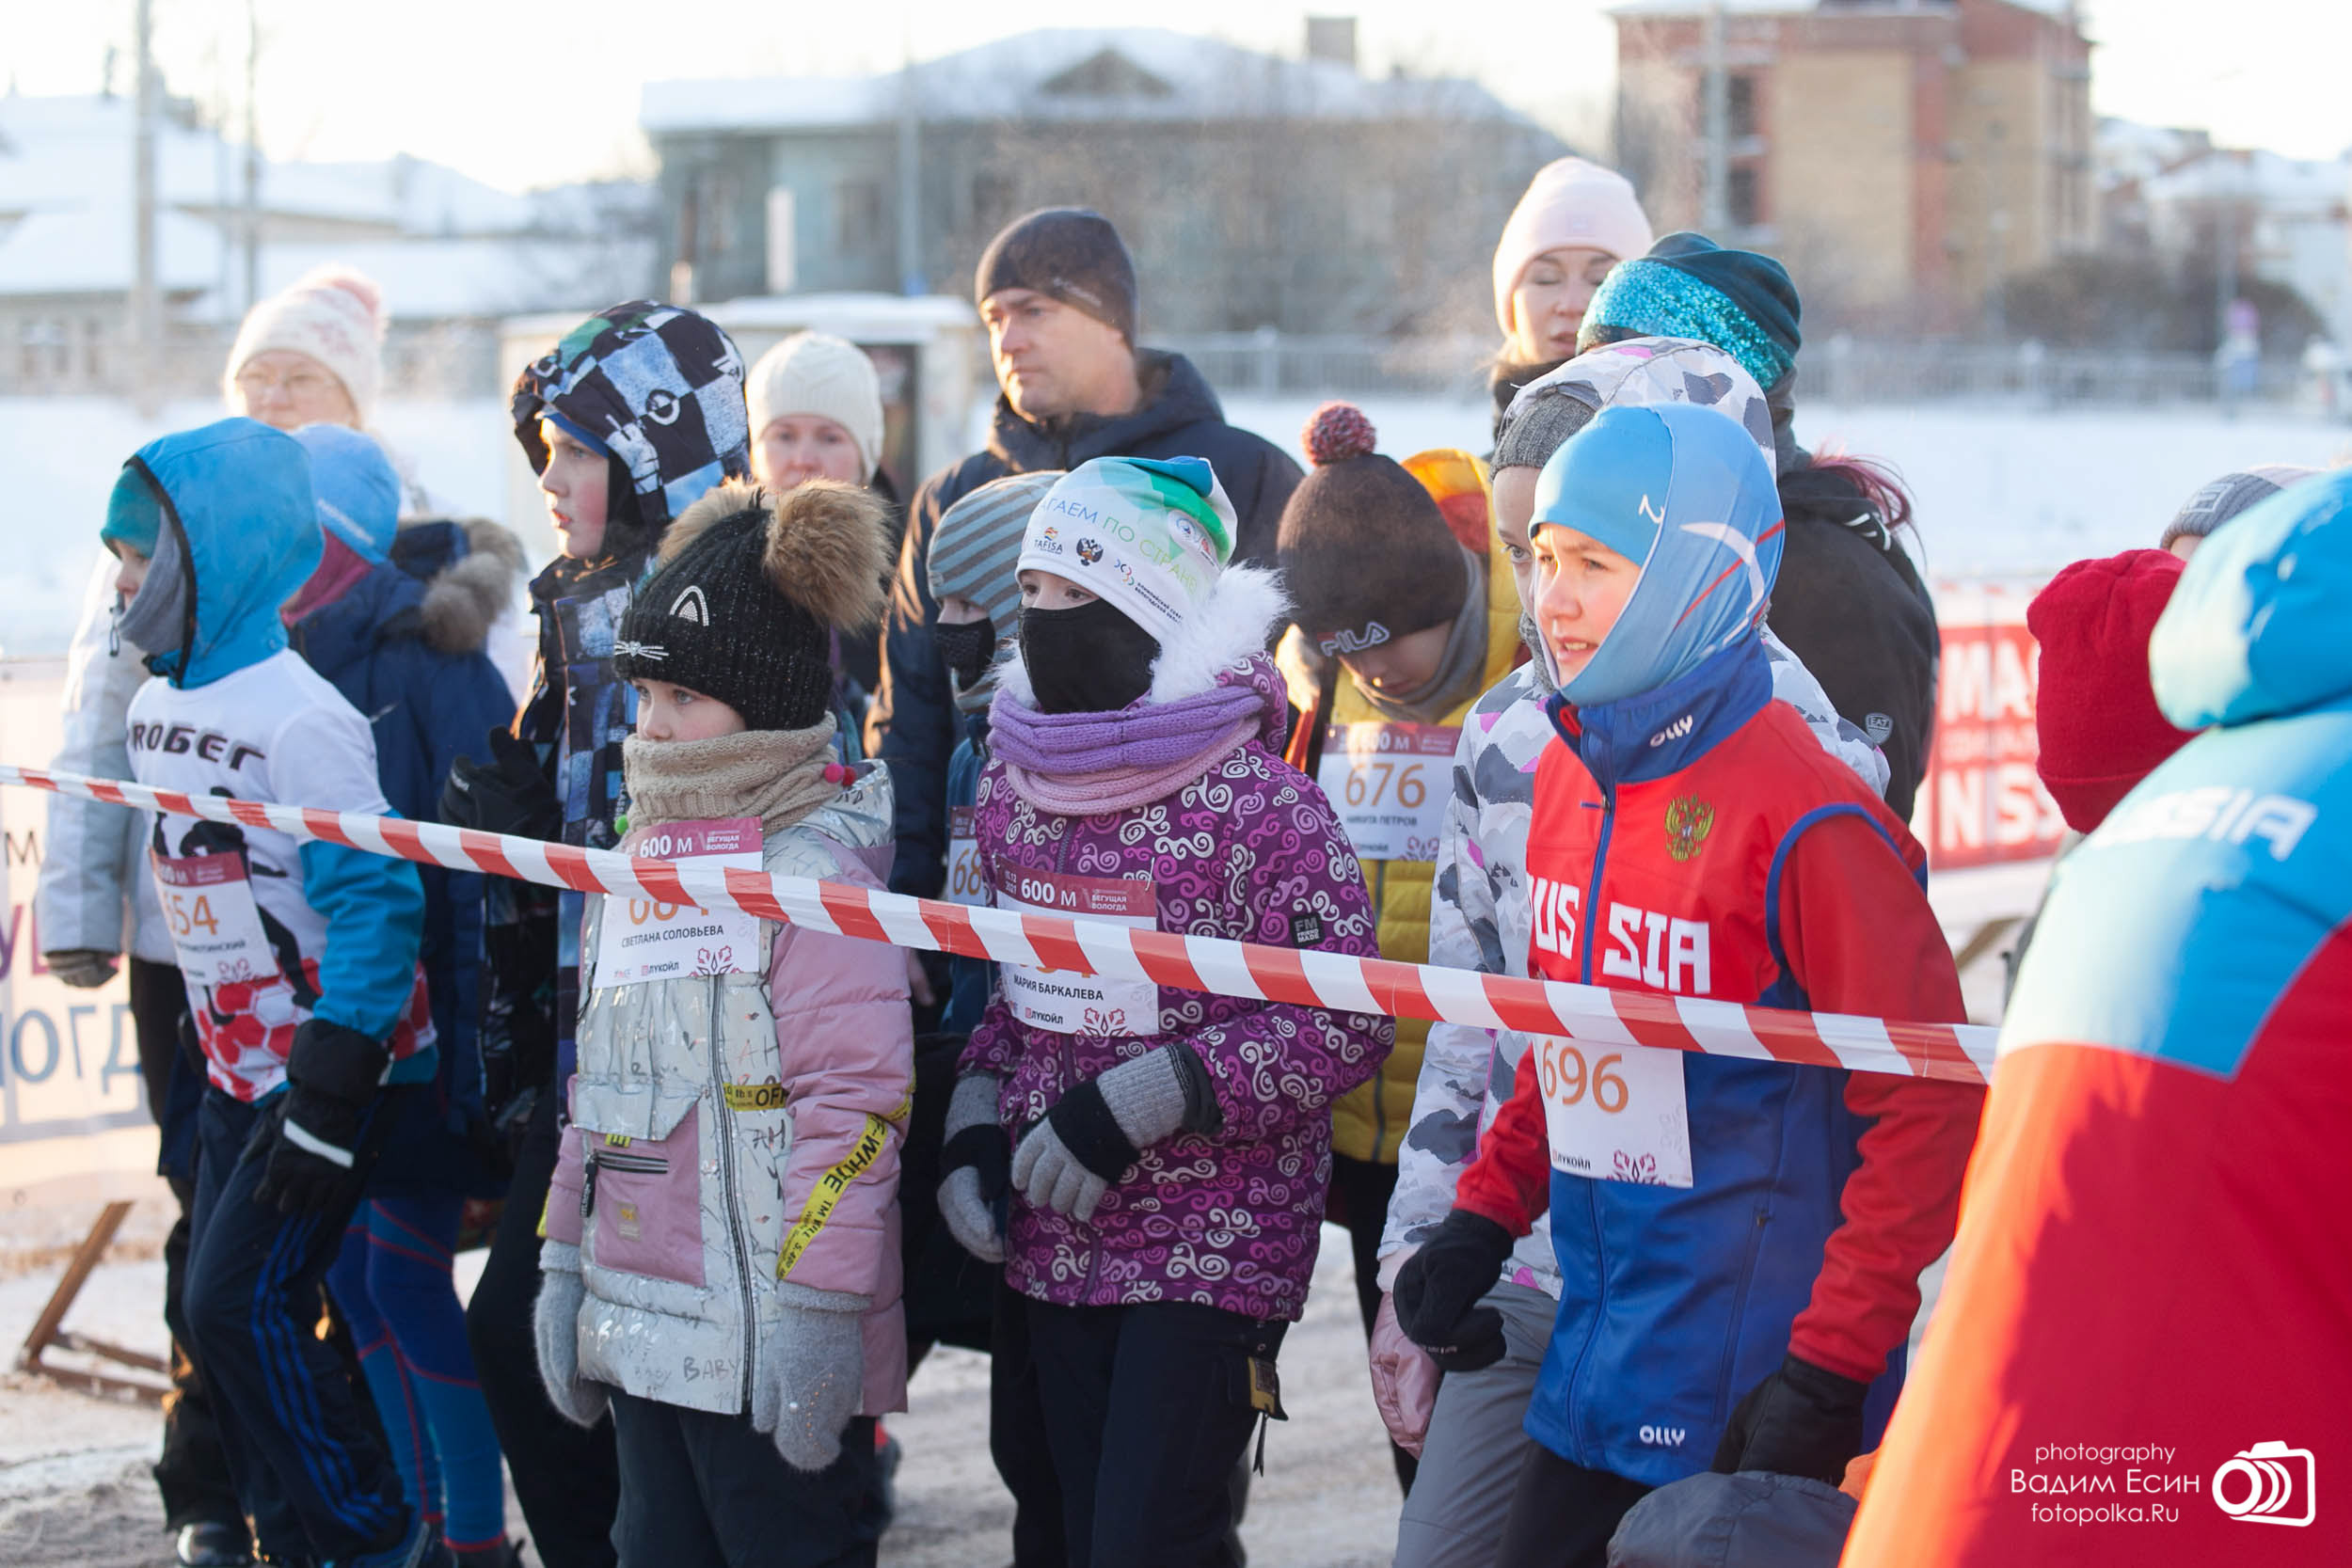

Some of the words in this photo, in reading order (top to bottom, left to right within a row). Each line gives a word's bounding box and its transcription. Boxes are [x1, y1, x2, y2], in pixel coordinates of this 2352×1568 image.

[1103, 515, 1135, 543] ПО
[1320, 621, 1390, 657] FILA
[1345, 763, 1426, 809] 676
[641, 834, 673, 859] 600
[1021, 878, 1056, 904] 600
[1091, 894, 1127, 903] БЕГУЩАЯ
[1091, 902, 1127, 911] ВОЛОГДА
[621, 932, 660, 948] СВЕТЛАНА
[662, 925, 723, 941] СОЛОВЬЕВА
[1295, 917, 1318, 932] FM
[648, 961, 679, 974] ЛУКОЙЛ
[1014, 974, 1037, 991] МАРИЯ
[1038, 982, 1104, 1001] БАРКАЛЕВА
[1030, 1010, 1063, 1024] ЛУКОЙЛ
[1542, 1038, 1629, 1114] 696
